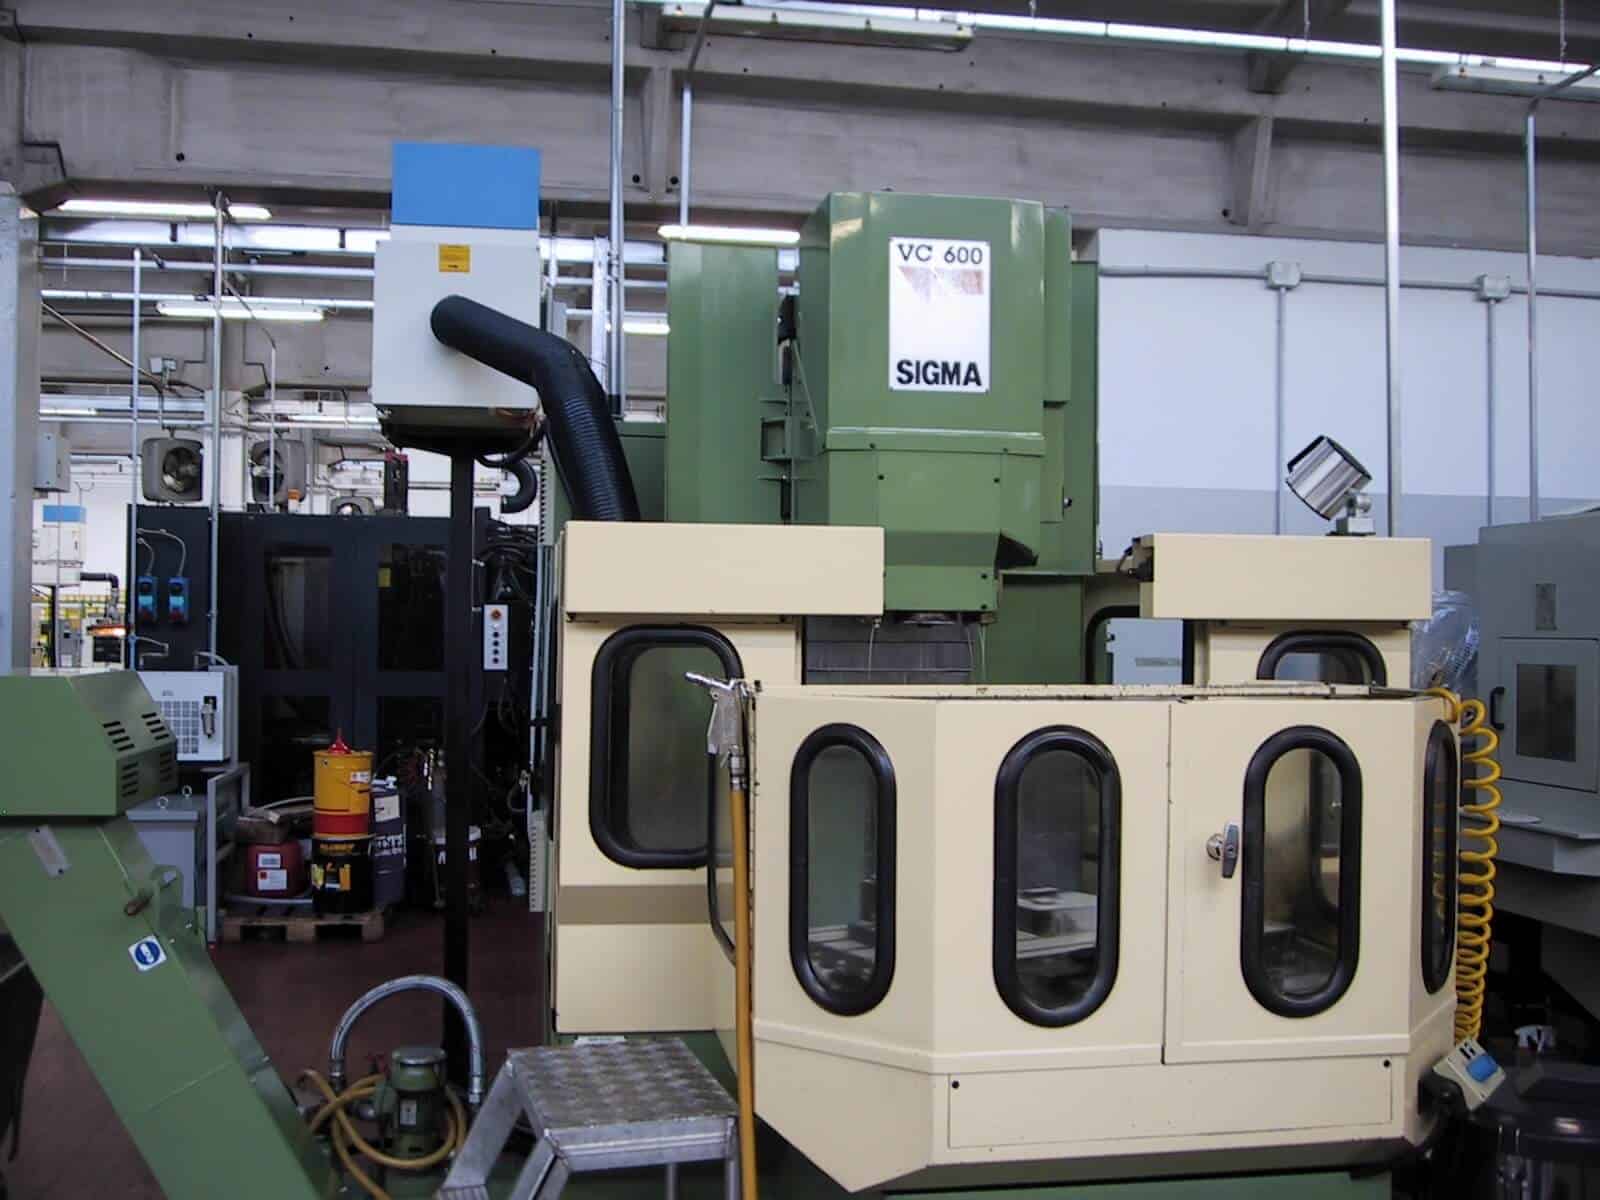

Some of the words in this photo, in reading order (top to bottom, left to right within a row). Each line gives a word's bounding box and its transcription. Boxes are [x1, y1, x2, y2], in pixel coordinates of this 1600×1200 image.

[897, 243, 933, 263] VC
[943, 246, 983, 265] 600
[896, 359, 982, 387] SIGMA
